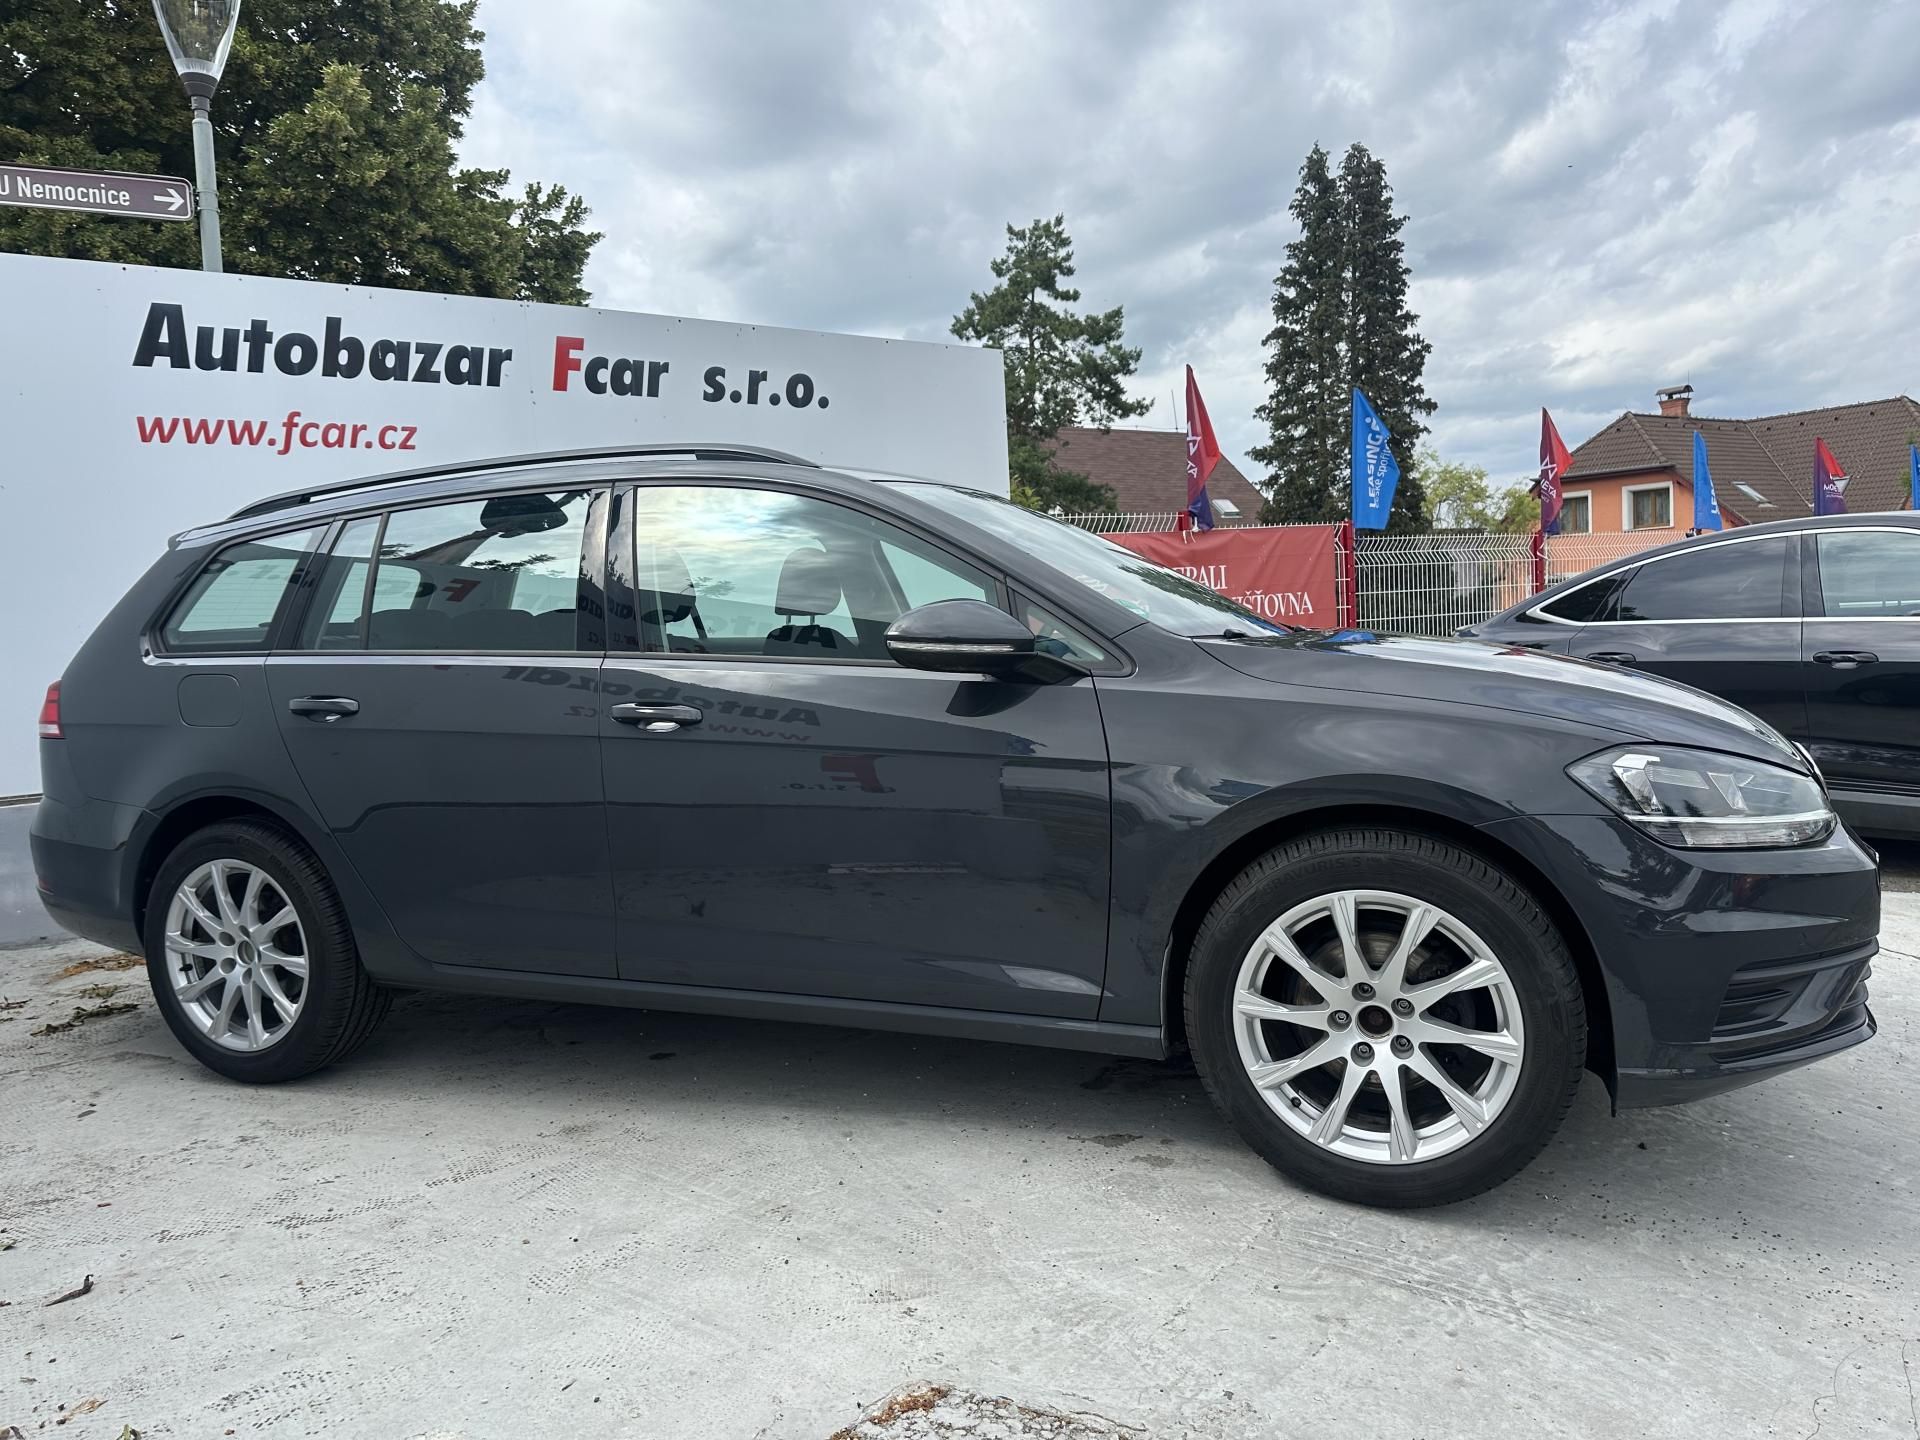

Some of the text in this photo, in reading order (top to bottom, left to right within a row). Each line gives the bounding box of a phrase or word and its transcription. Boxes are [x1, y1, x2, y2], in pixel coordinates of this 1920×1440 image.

[17, 176, 130, 206] Nemocnice
[132, 302, 829, 409] Autobazar Fcar s.r.o.
[136, 411, 418, 455] www.fcar.cz
[1365, 433, 1382, 508] LEASING
